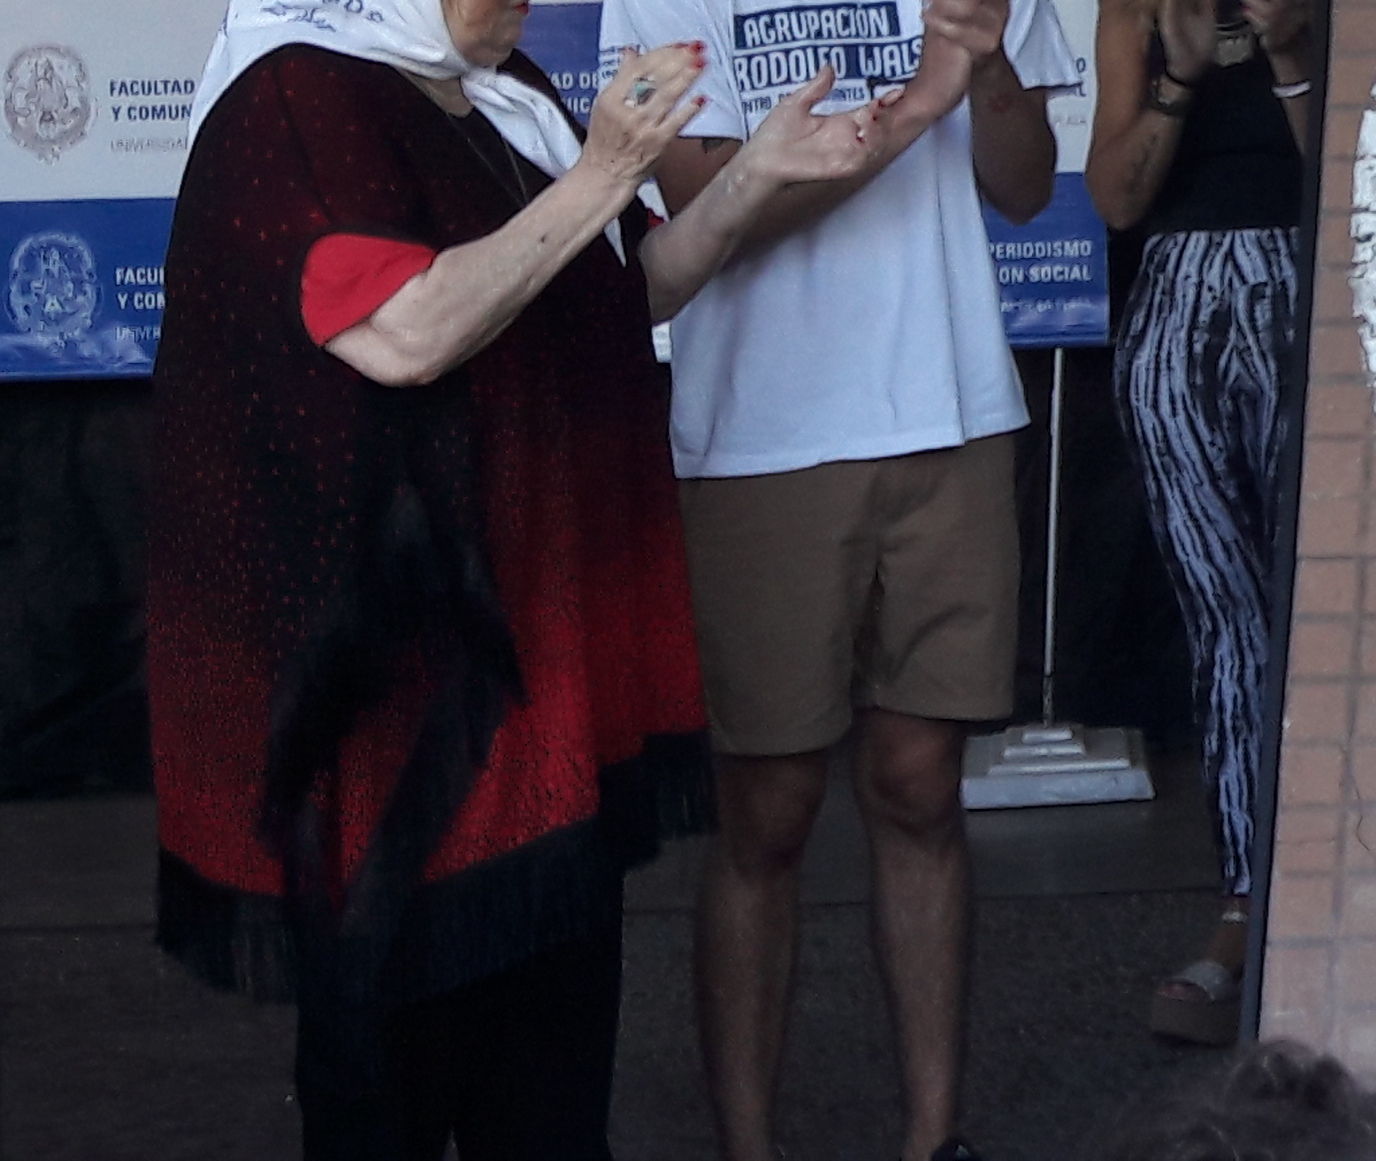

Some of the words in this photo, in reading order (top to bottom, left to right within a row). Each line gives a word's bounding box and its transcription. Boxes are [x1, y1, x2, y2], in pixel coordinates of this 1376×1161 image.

[743, 3, 890, 46] AGRUPACIÓN
[109, 79, 196, 97] FACULTAD
[579, 72, 598, 89] DE
[111, 106, 122, 121] Y
[1028, 264, 1093, 284] SOCIAL
[117, 292, 129, 310] Y
